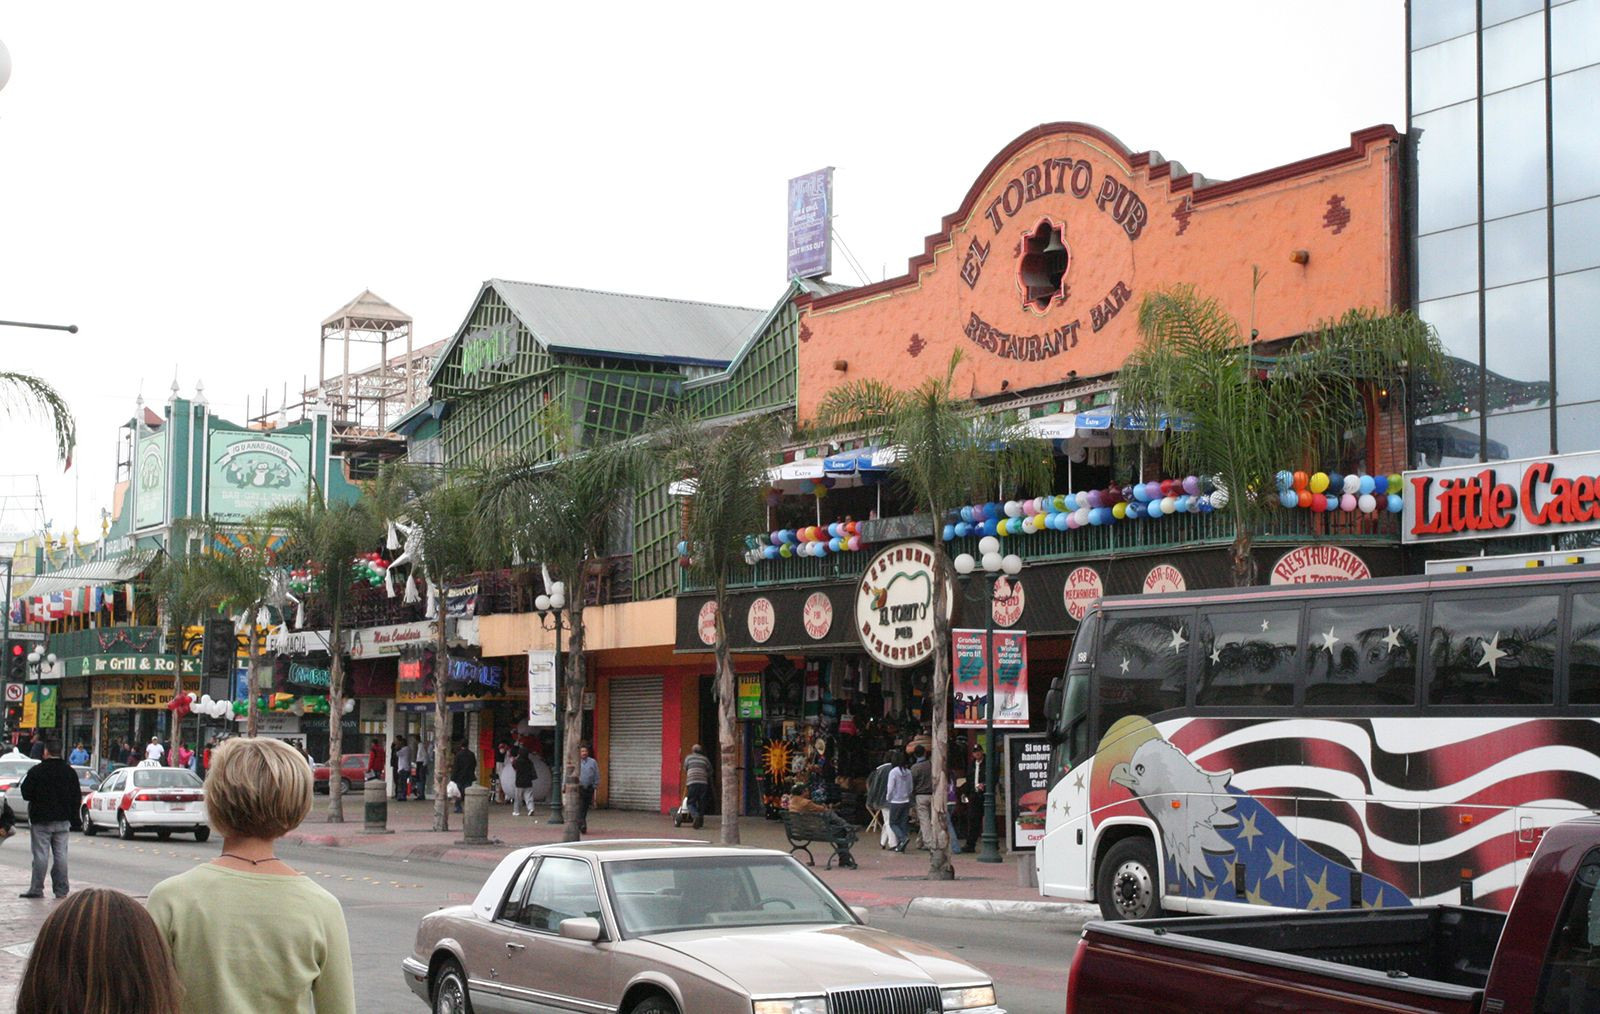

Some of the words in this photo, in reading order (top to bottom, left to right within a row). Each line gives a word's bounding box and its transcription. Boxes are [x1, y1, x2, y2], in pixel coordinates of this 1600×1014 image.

[960, 235, 991, 290] EL
[985, 157, 1093, 236] TORITO
[1096, 174, 1148, 241] PUB
[964, 311, 1081, 362] RESTAURANT
[1089, 280, 1133, 333] BAR
[1410, 468, 1514, 535] Little
[1274, 546, 1369, 580] RESTAURANT
[1069, 568, 1097, 588] FREE
[752, 600, 770, 614] FREE
[890, 602, 926, 623] TORITO
[752, 615, 769, 626] POOL
[894, 626, 913, 640] PUB
[110, 657, 136, 671] Grill
[139, 657, 151, 670] &
[154, 658, 194, 672] Rok
[1077, 653, 1087, 662] 198
[1025, 743, 1032, 751] Si
